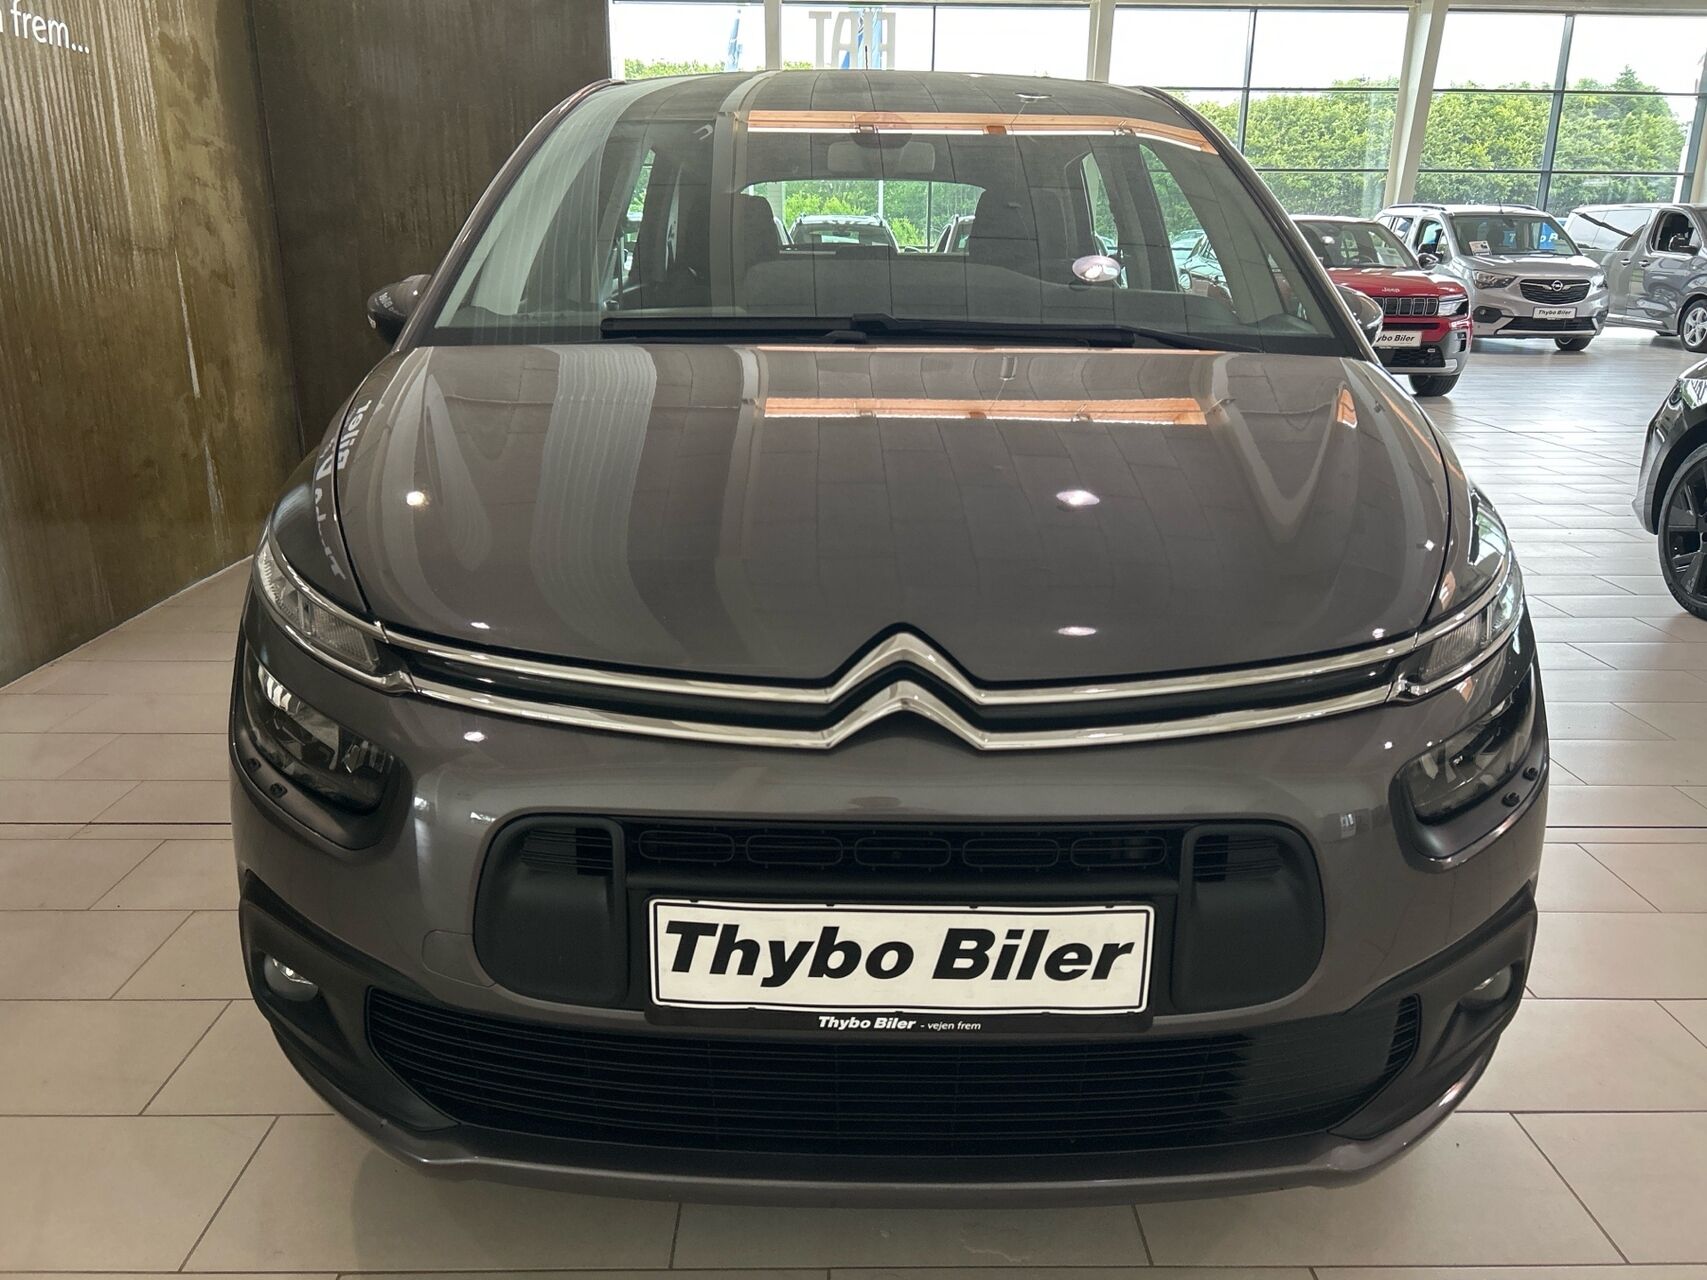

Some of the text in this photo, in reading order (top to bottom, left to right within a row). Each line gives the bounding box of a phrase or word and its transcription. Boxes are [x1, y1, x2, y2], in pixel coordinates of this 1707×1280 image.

[1394, 334, 1415, 342] Biler
[665, 920, 1135, 988] Thybo Biler
[818, 1016, 871, 1030] Thybo
[873, 1017, 916, 1029] Biler
[927, 1021, 955, 1031] vejen
[957, 1021, 982, 1030] frem
